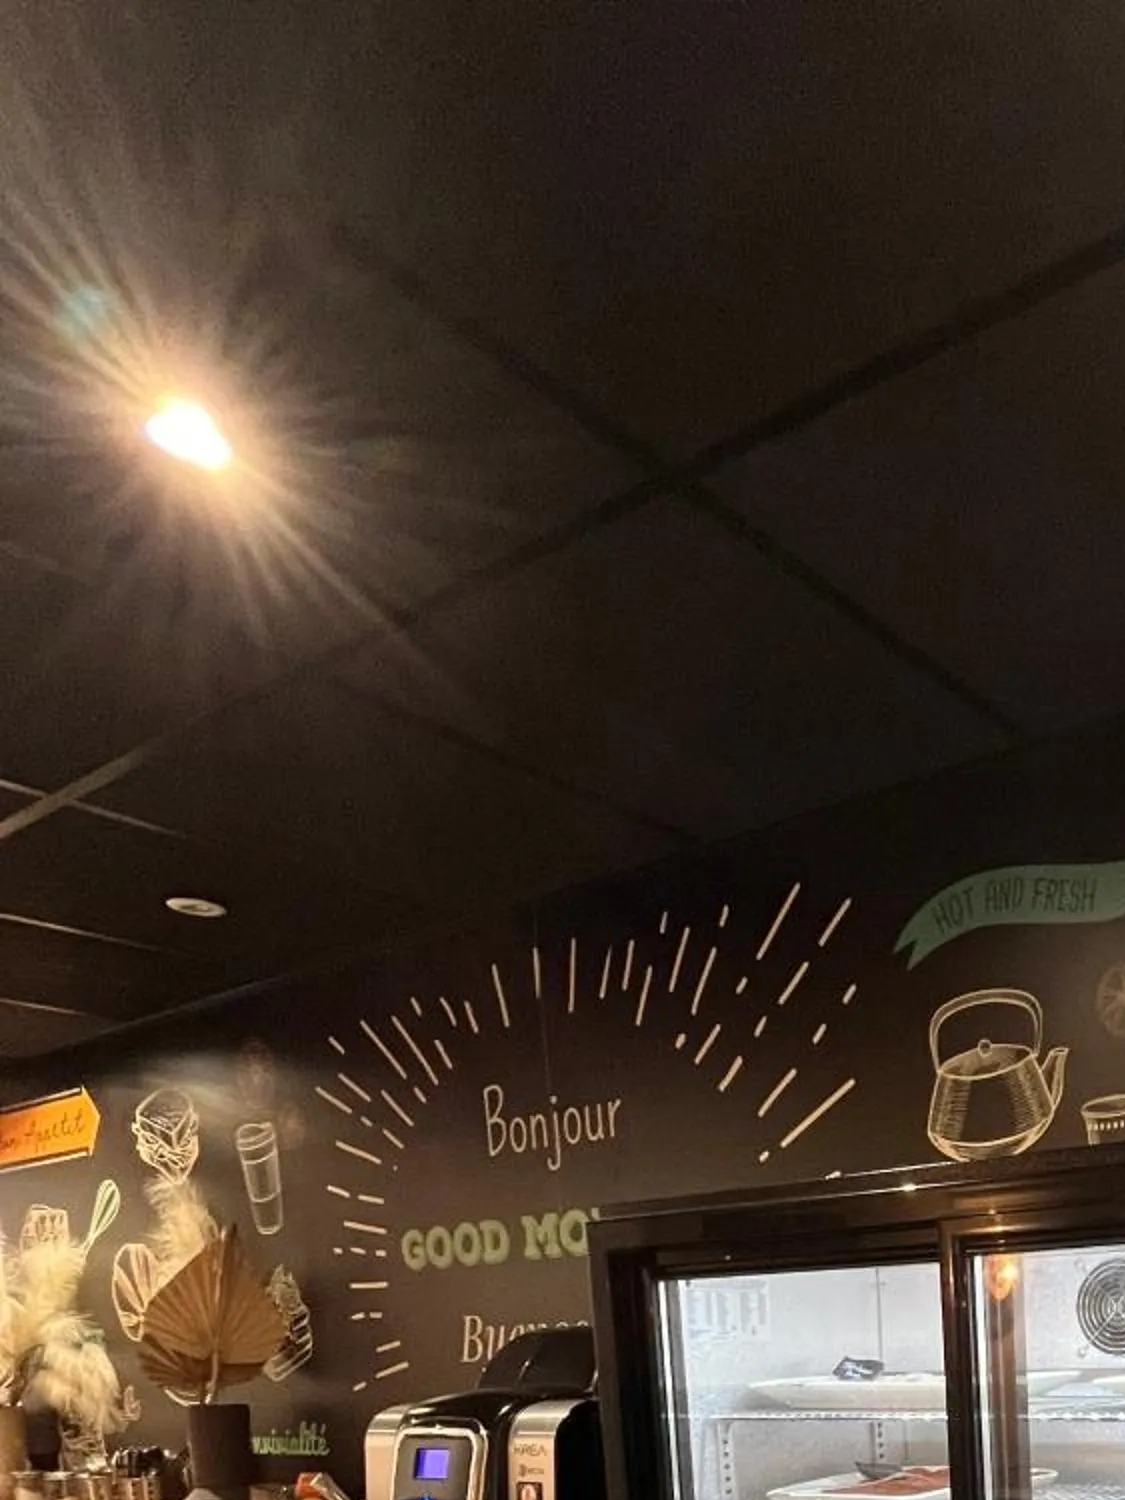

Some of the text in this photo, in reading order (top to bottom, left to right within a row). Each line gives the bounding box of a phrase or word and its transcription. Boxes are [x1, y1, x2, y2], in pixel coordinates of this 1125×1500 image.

[931, 875, 1098, 936] HOT AND FRESH
[483, 1084, 621, 1171] Bonjour
[401, 1208, 600, 1271] GOOD MO
